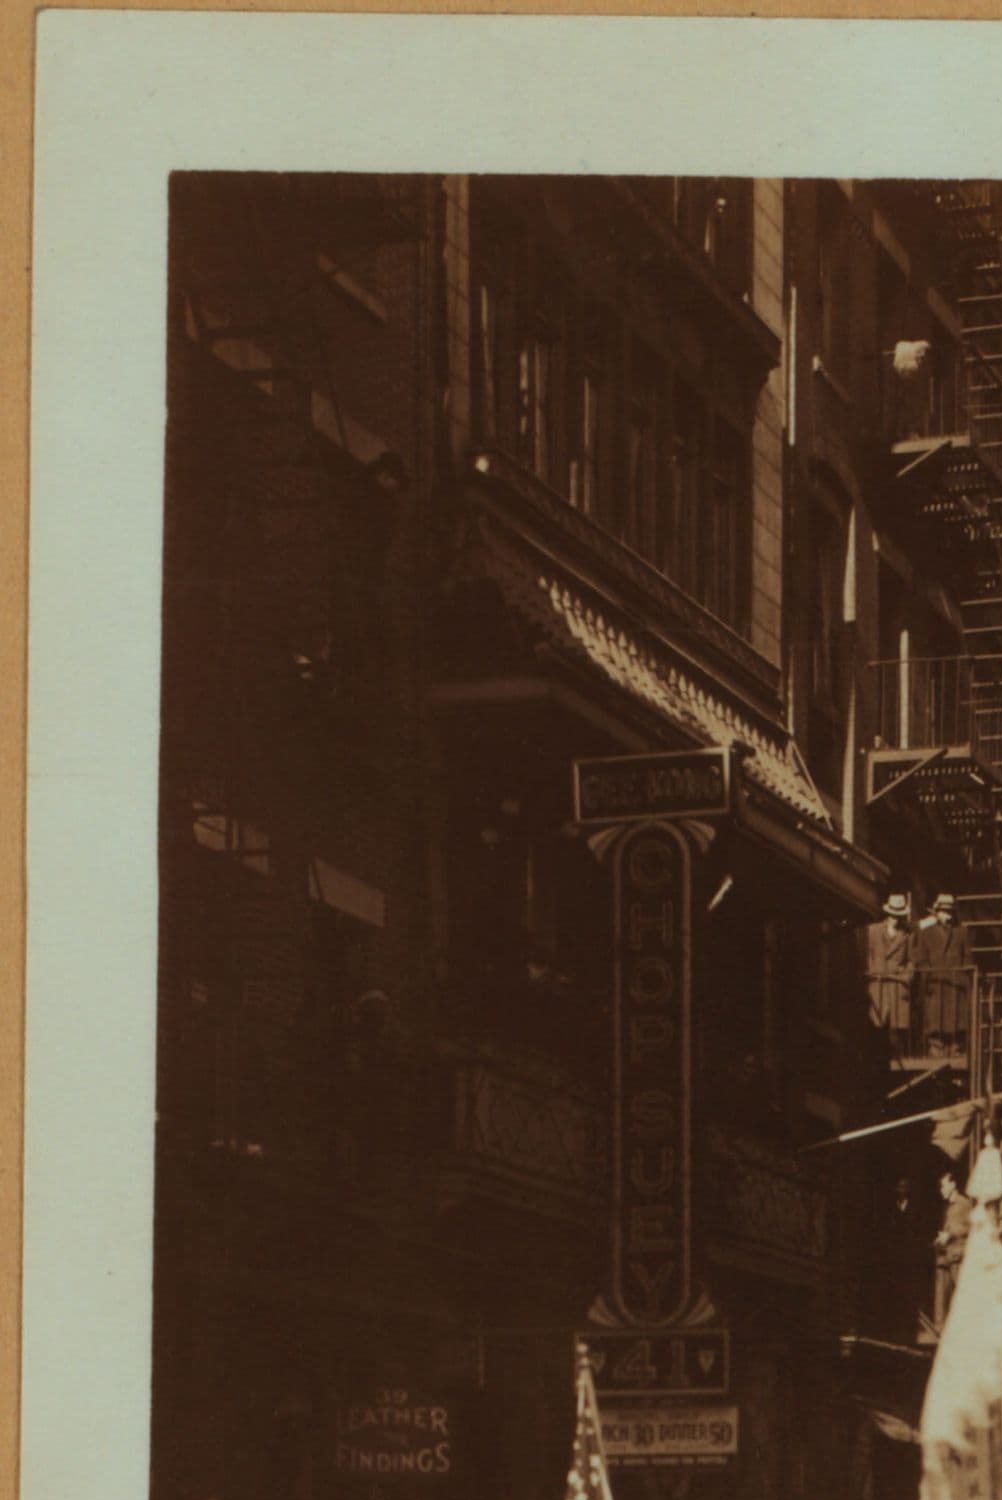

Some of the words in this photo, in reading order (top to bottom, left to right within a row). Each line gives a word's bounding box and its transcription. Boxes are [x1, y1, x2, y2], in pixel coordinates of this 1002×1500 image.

[629, 839, 674, 1063] CHOP
[629, 1089, 675, 1313] SUEY
[611, 1339, 690, 1388] 41
[336, 1405, 449, 1437] LEATHER
[709, 1421, 733, 1446] 50
[335, 1438, 451, 1473] FINDINGS
